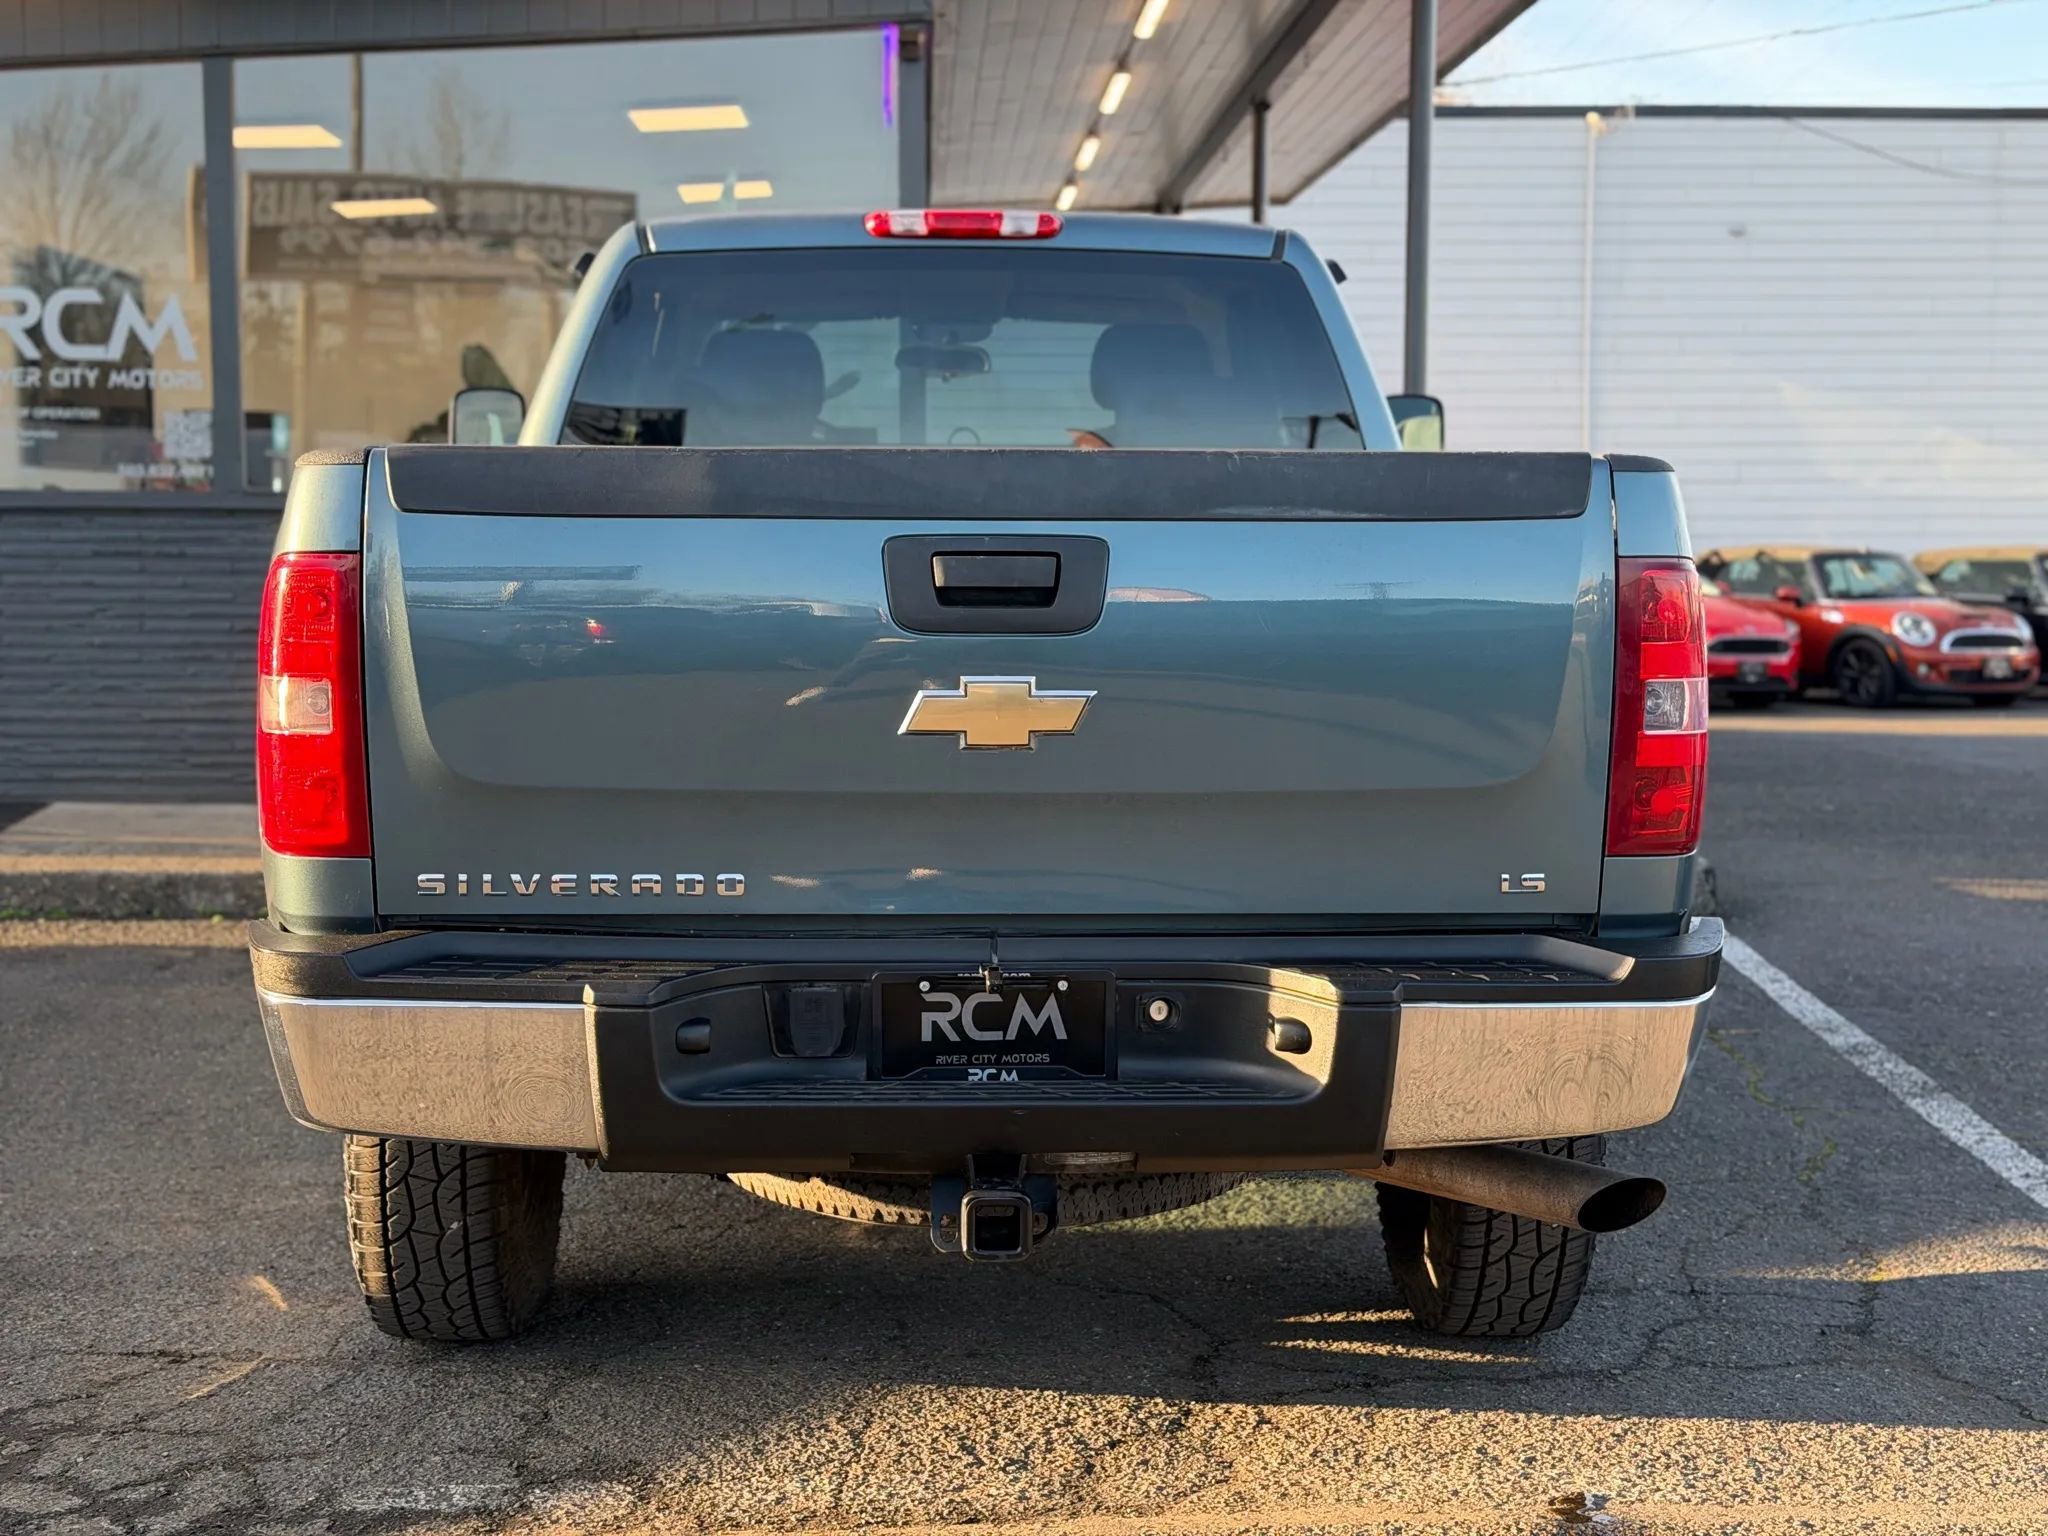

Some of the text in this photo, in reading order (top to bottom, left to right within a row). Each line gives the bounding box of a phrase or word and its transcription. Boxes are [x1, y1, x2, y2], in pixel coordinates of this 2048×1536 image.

[0, 286, 197, 361] RCM
[49, 367, 99, 389] CITY
[416, 872, 745, 896] SILVERADO
[1501, 873, 1545, 893] LS
[920, 992, 1068, 1041] RCM
[935, 1053, 1050, 1065] RIVER CITY MOTORS
[967, 1068, 1019, 1082] RCM
